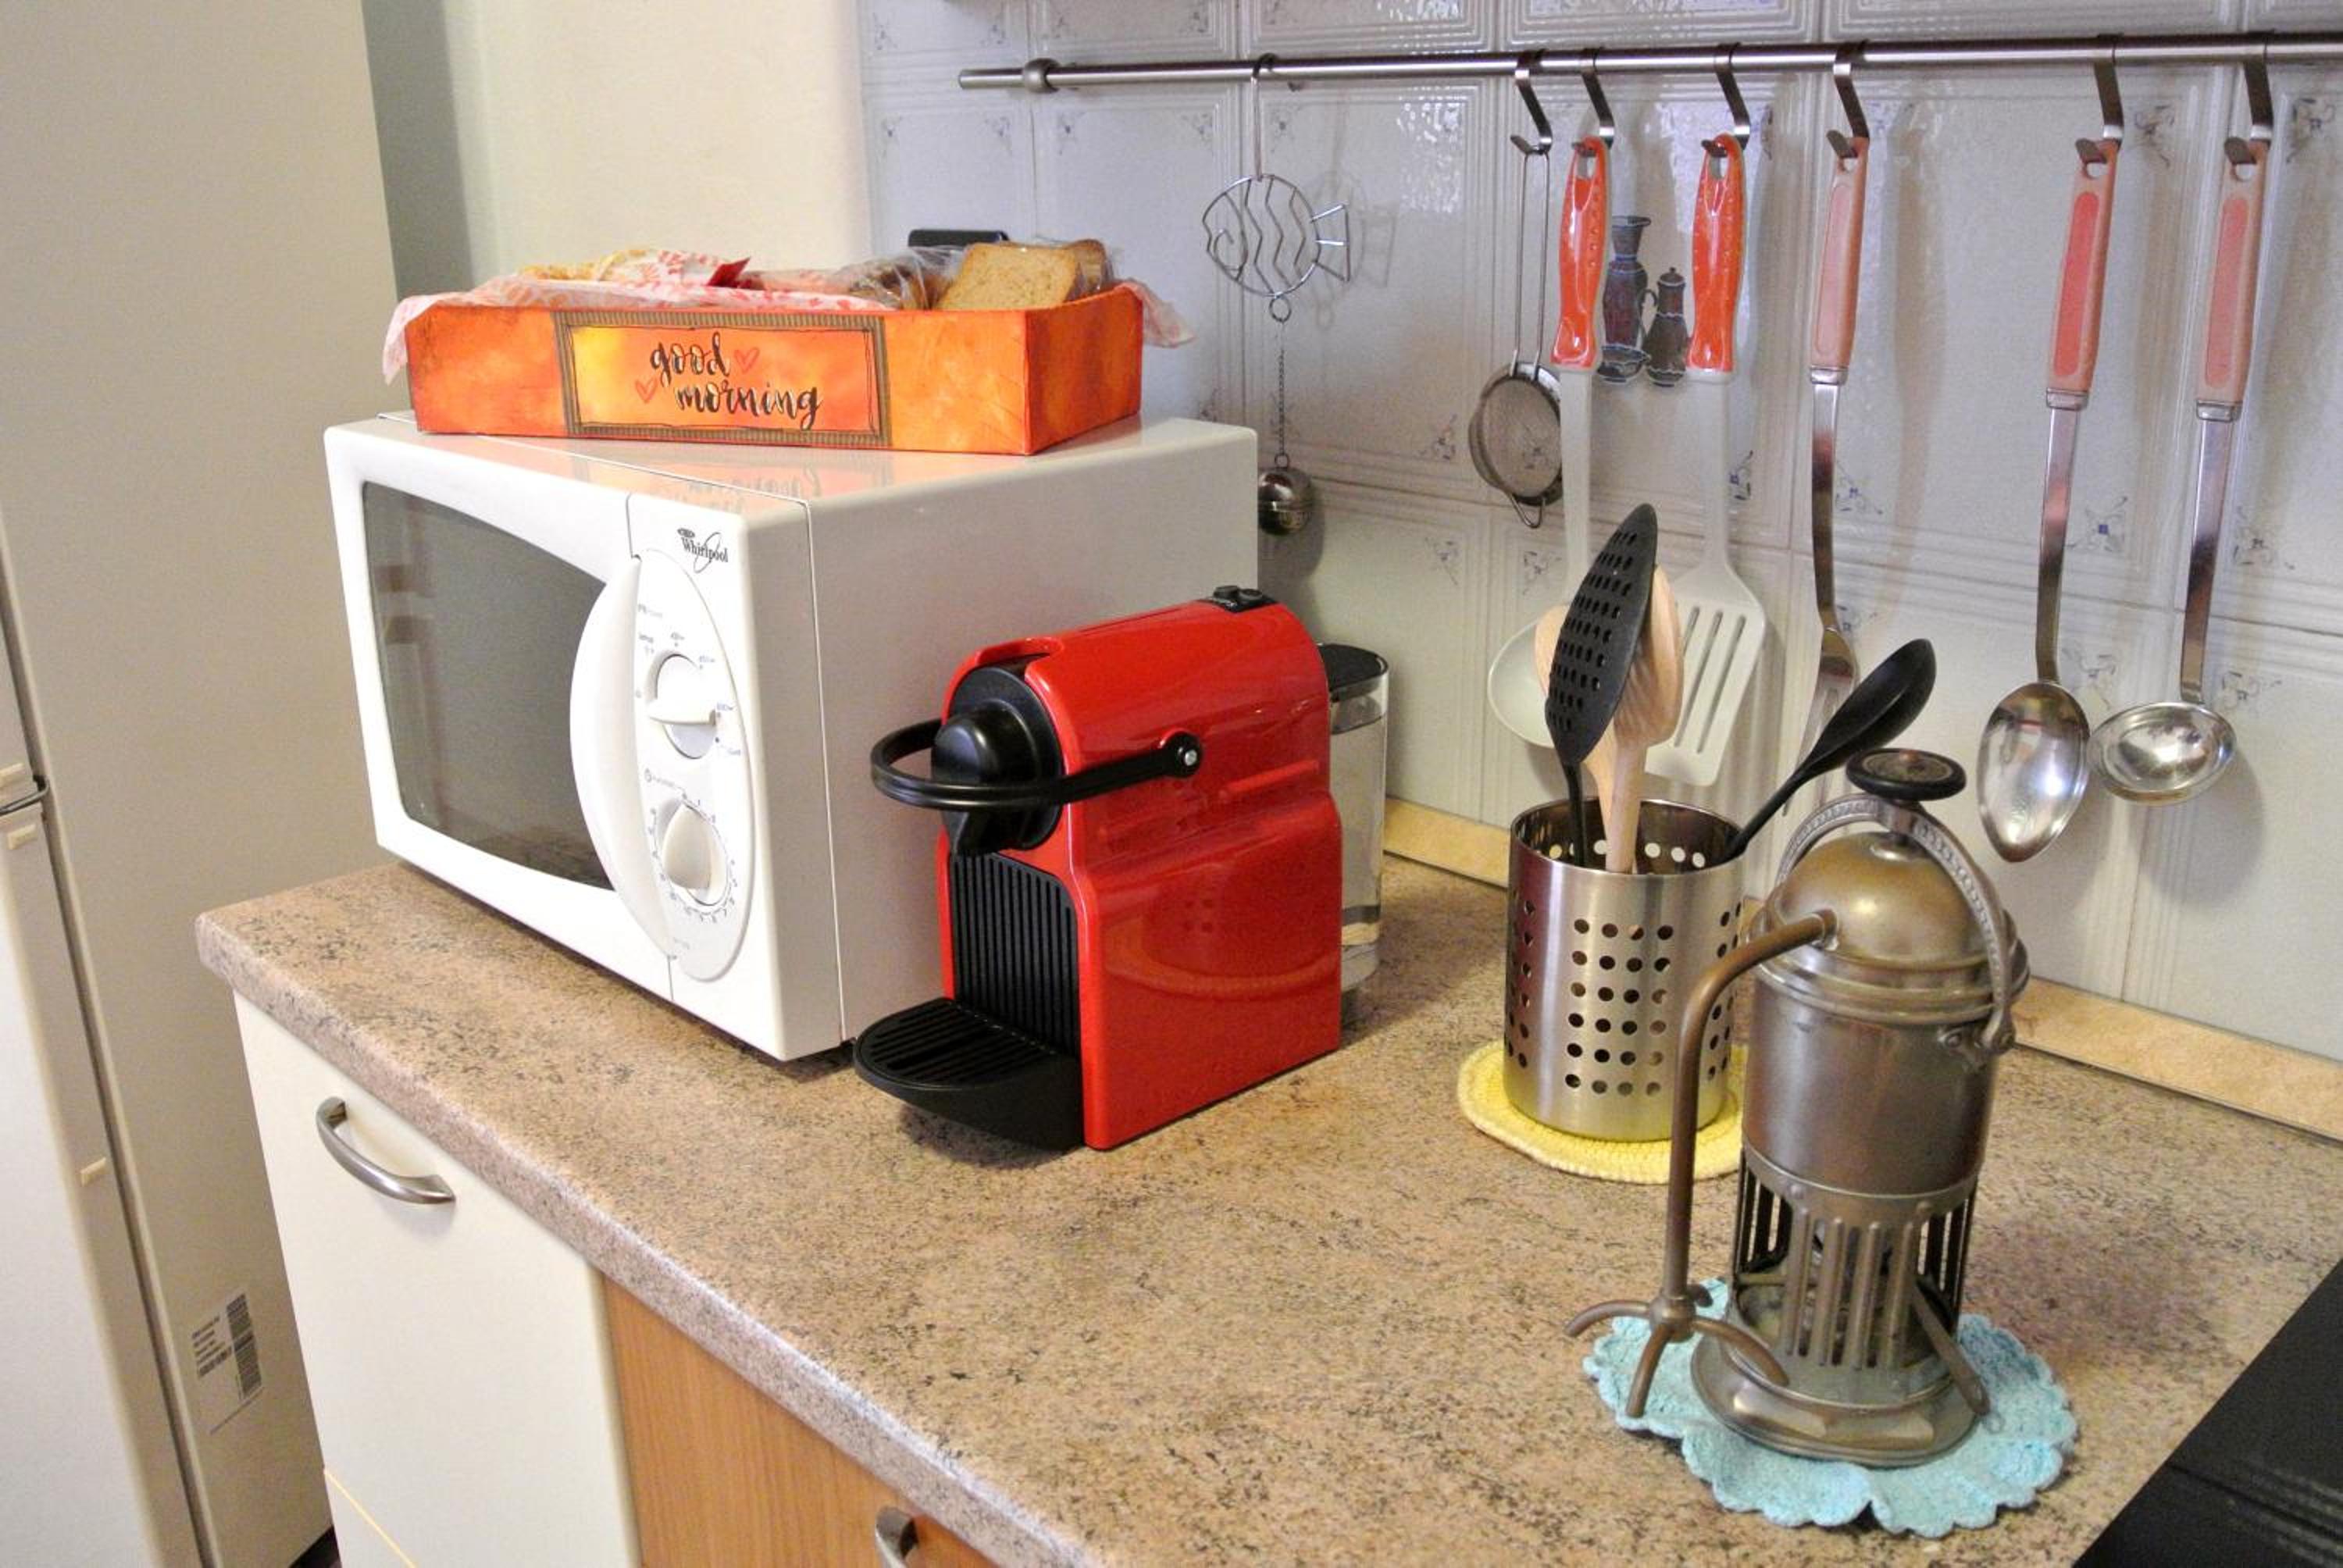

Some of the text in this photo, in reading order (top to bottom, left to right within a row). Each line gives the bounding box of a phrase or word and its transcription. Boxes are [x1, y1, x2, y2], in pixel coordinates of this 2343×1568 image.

[650, 331, 730, 388] good
[675, 379, 823, 430] morning
[681, 536, 729, 563] Whirlpool
